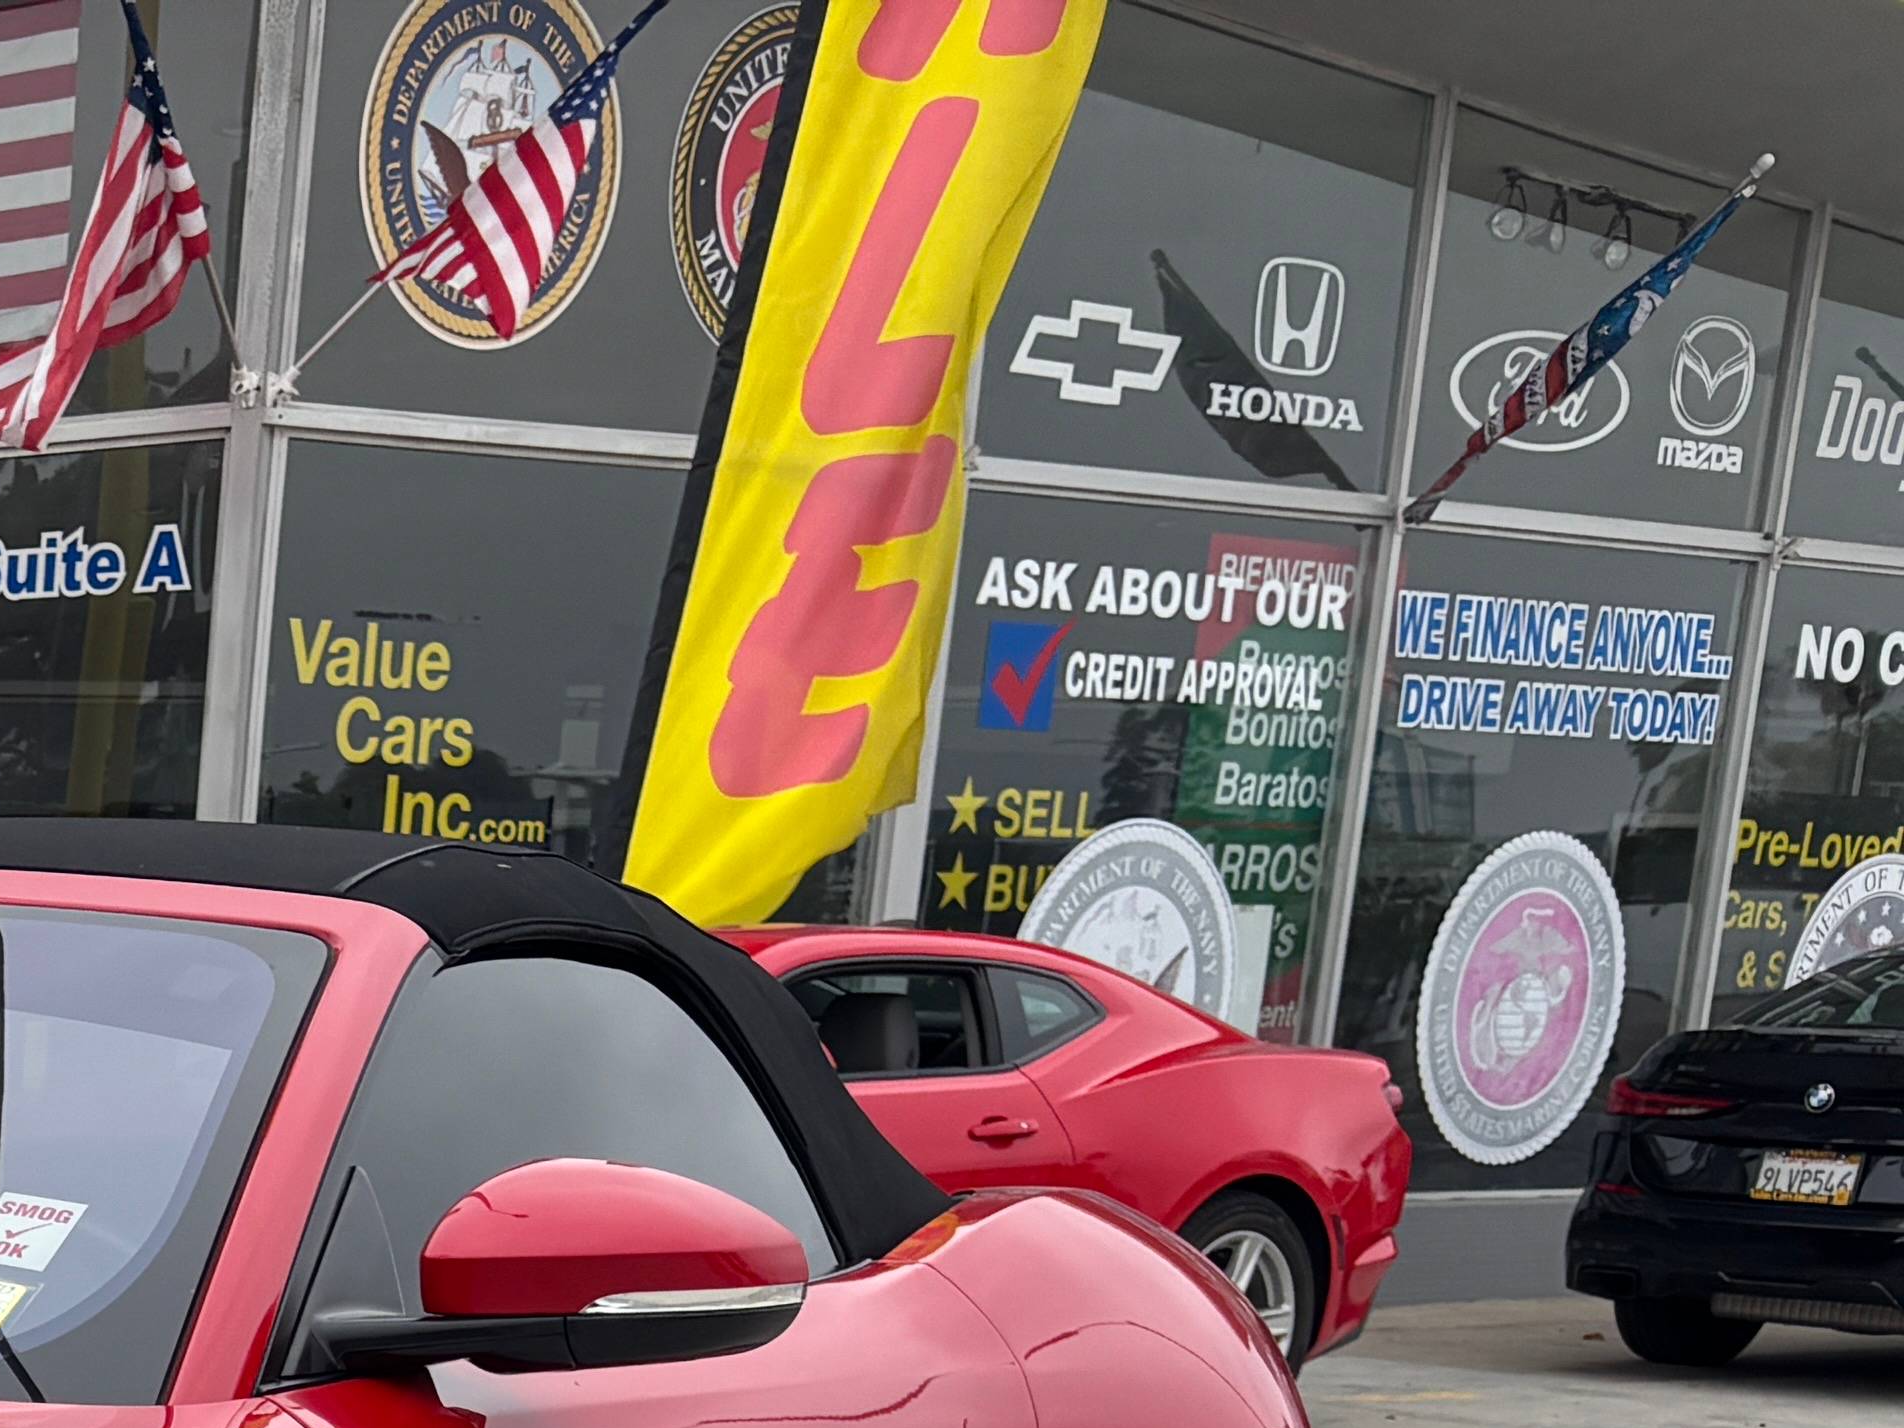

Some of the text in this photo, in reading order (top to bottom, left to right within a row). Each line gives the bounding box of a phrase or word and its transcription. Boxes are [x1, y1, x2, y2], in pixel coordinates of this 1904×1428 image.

[392, 3, 575, 125] DEPARTMENT OF THE
[709, 42, 792, 132] UNITE
[385, 161, 418, 249] UNITE
[538, 191, 591, 284] MERICA
[1206, 382, 1364, 431] HONDA
[1489, 346, 1593, 427] Frd
[133, 524, 192, 594] A
[976, 557, 1347, 630] ASK ABOUT OUR
[289, 617, 451, 692] Value
[1395, 590, 1733, 679] WE FINANCE ANYONE...
[1794, 623, 1865, 683] NO
[1065, 651, 1322, 711] CREDIT APPROVAL
[1397, 673, 1720, 745] DRIVE AWAY TODAY!
[336, 696, 474, 767] Cars
[994, 788, 1098, 838] SELL
[984, 864, 1055, 912] BU
[1205, 843, 1323, 892] RROS
[1864, 868, 1888, 892] OF
[1140, 856, 1168, 879] OF
[1170, 868, 1200, 913] THE
[1194, 909, 1218, 975] NAVY
[1446, 858, 1611, 973] DEPARTMENT OF THE NAVY
[1736, 951, 1757, 988] &
